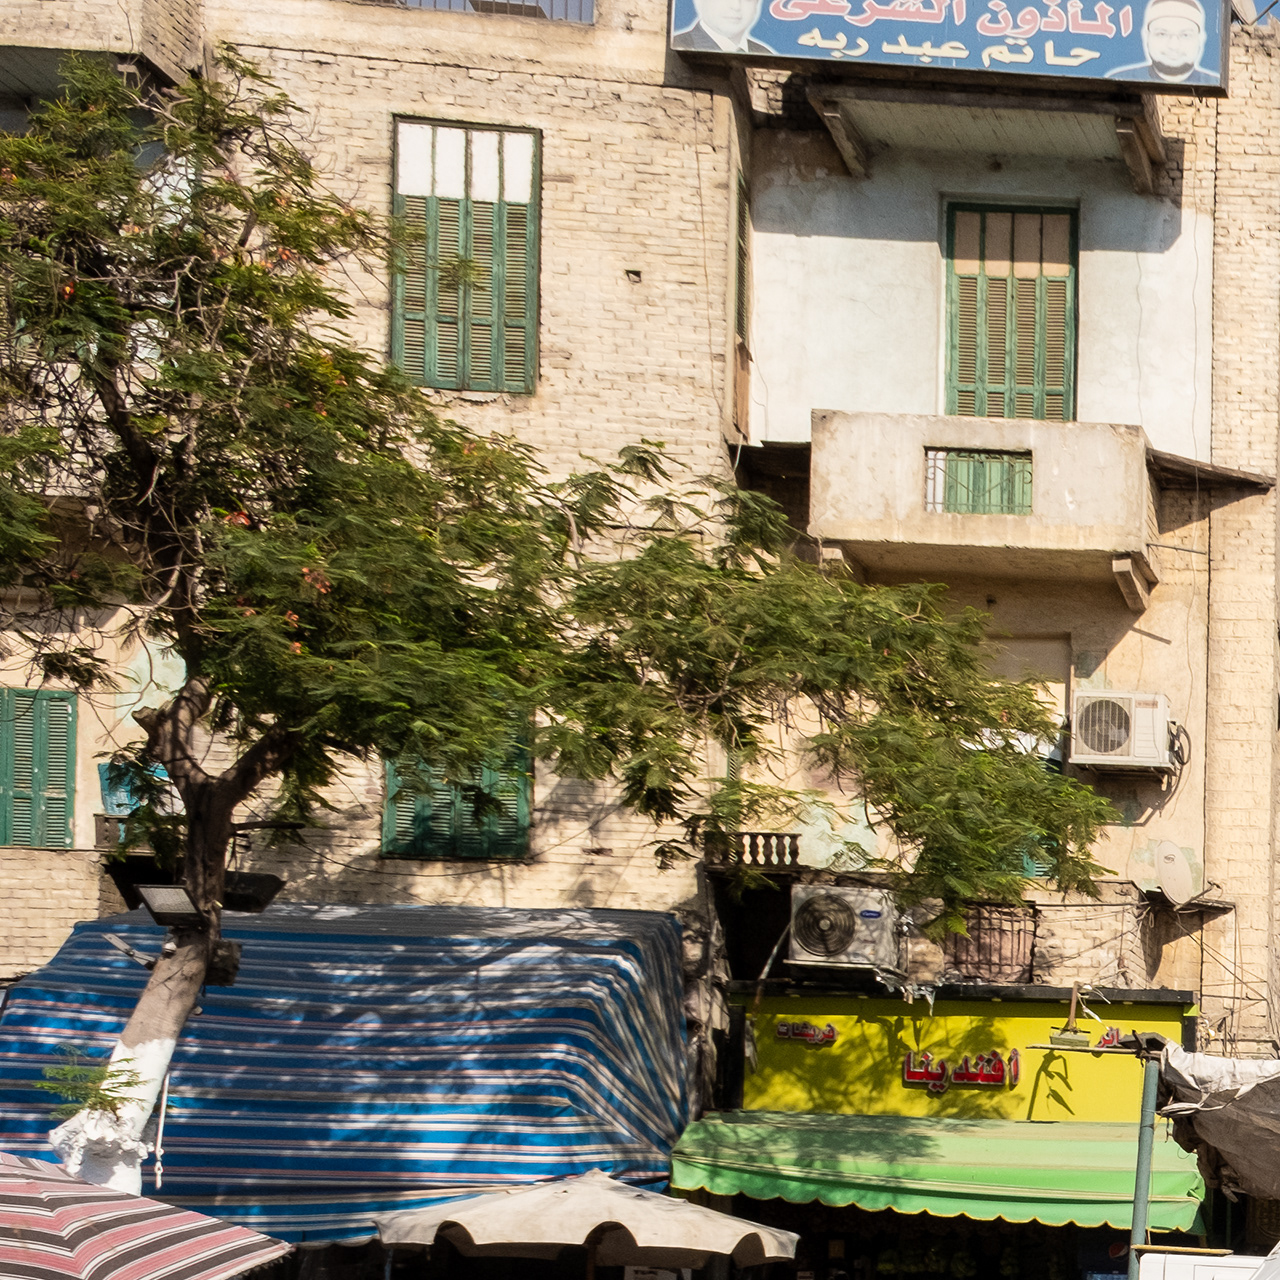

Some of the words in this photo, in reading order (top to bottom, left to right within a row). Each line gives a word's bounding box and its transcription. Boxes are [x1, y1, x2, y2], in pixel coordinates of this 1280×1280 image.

[976, 0, 1133, 38] المأذون
[797, 27, 869, 59] ربه
[881, 33, 970, 63] عبد
[981, 38, 1101, 68] حاتم
[903, 1048, 1020, 1092] أفندينا
